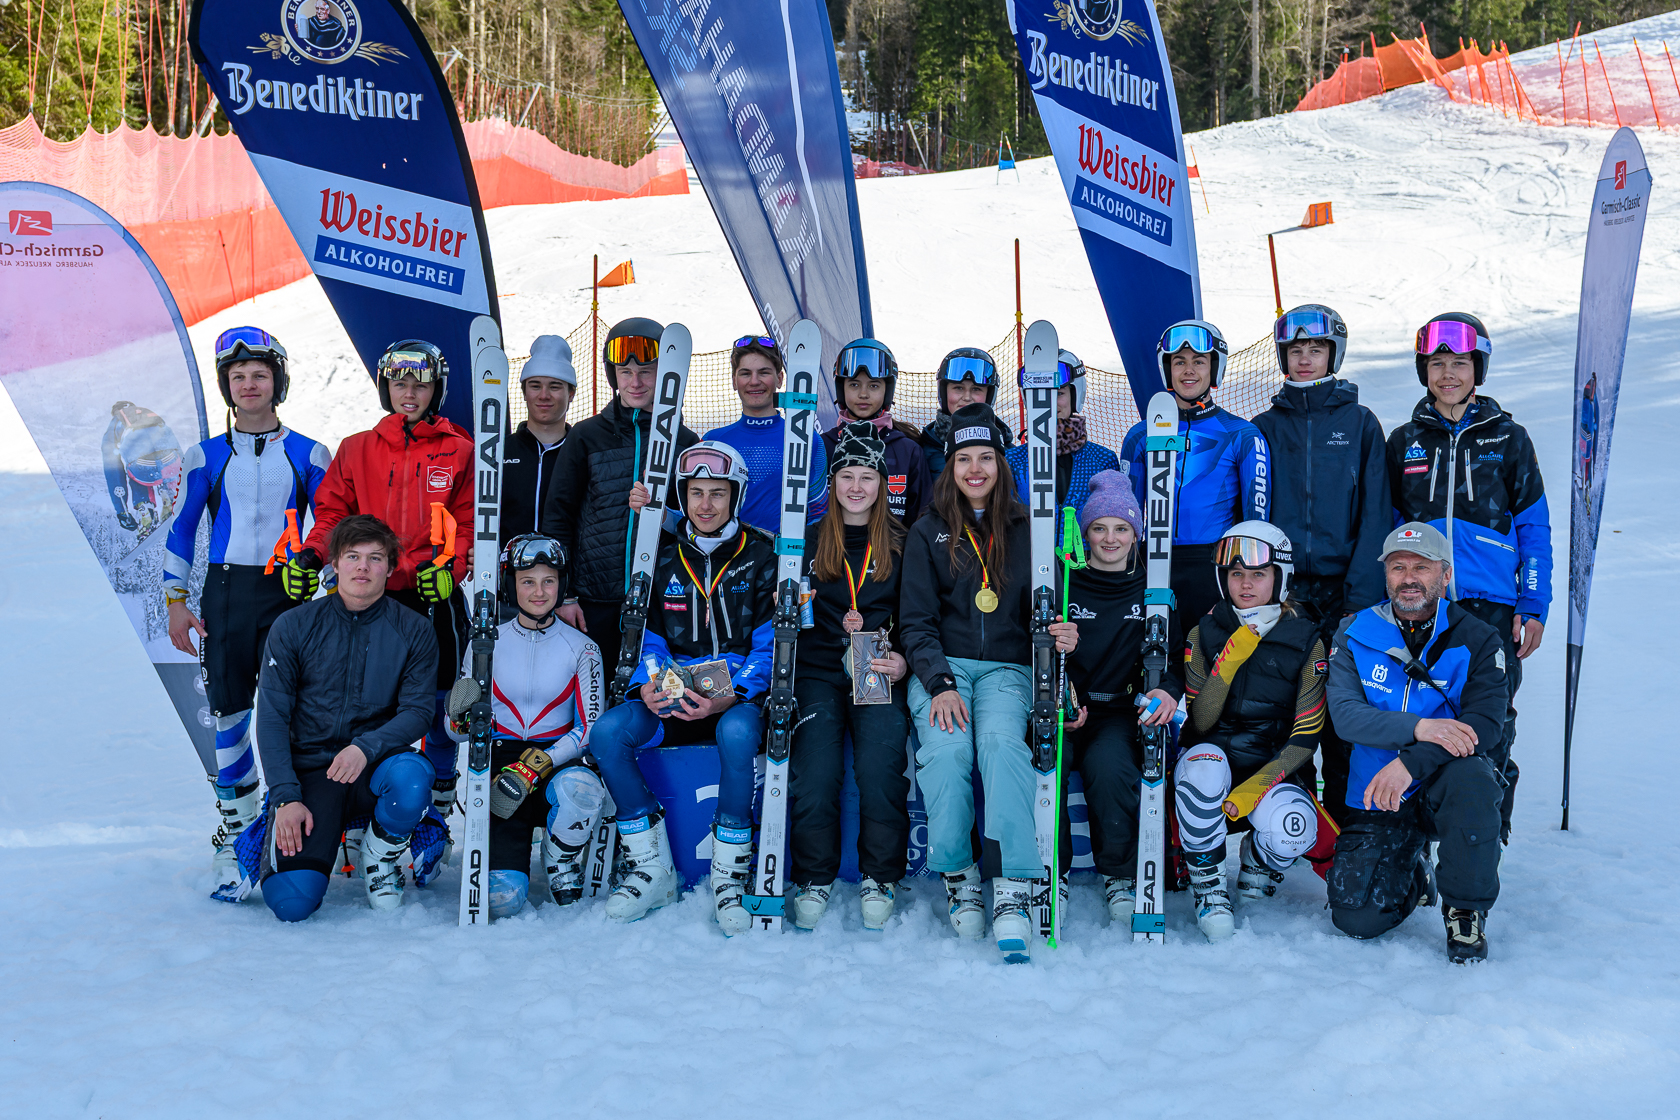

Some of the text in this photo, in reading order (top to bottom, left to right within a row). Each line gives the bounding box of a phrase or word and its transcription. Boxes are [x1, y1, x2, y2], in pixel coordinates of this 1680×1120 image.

[221, 61, 424, 121] Benediktiner
[1027, 29, 1160, 111] Benediktiner
[1078, 123, 1175, 207] Weissbier
[319, 188, 467, 258] Weissbier
[1081, 186, 1166, 236] ALKOHOLFREI
[325, 244, 454, 286] ALKOHOLFREI
[648, 371, 681, 509] HEAD
[1405, 450, 1427, 459] ASV
[477, 397, 501, 541] HEAD
[1254, 436, 1267, 520] ziener
[1275, 551, 1292, 561] uvex
[1526, 569, 1538, 591] AÜW
[665, 586, 685, 595] ASV
[587, 671, 600, 723] Schöffel
[515, 763, 532, 778] LEKI
[720, 830, 748, 839] HEAD
